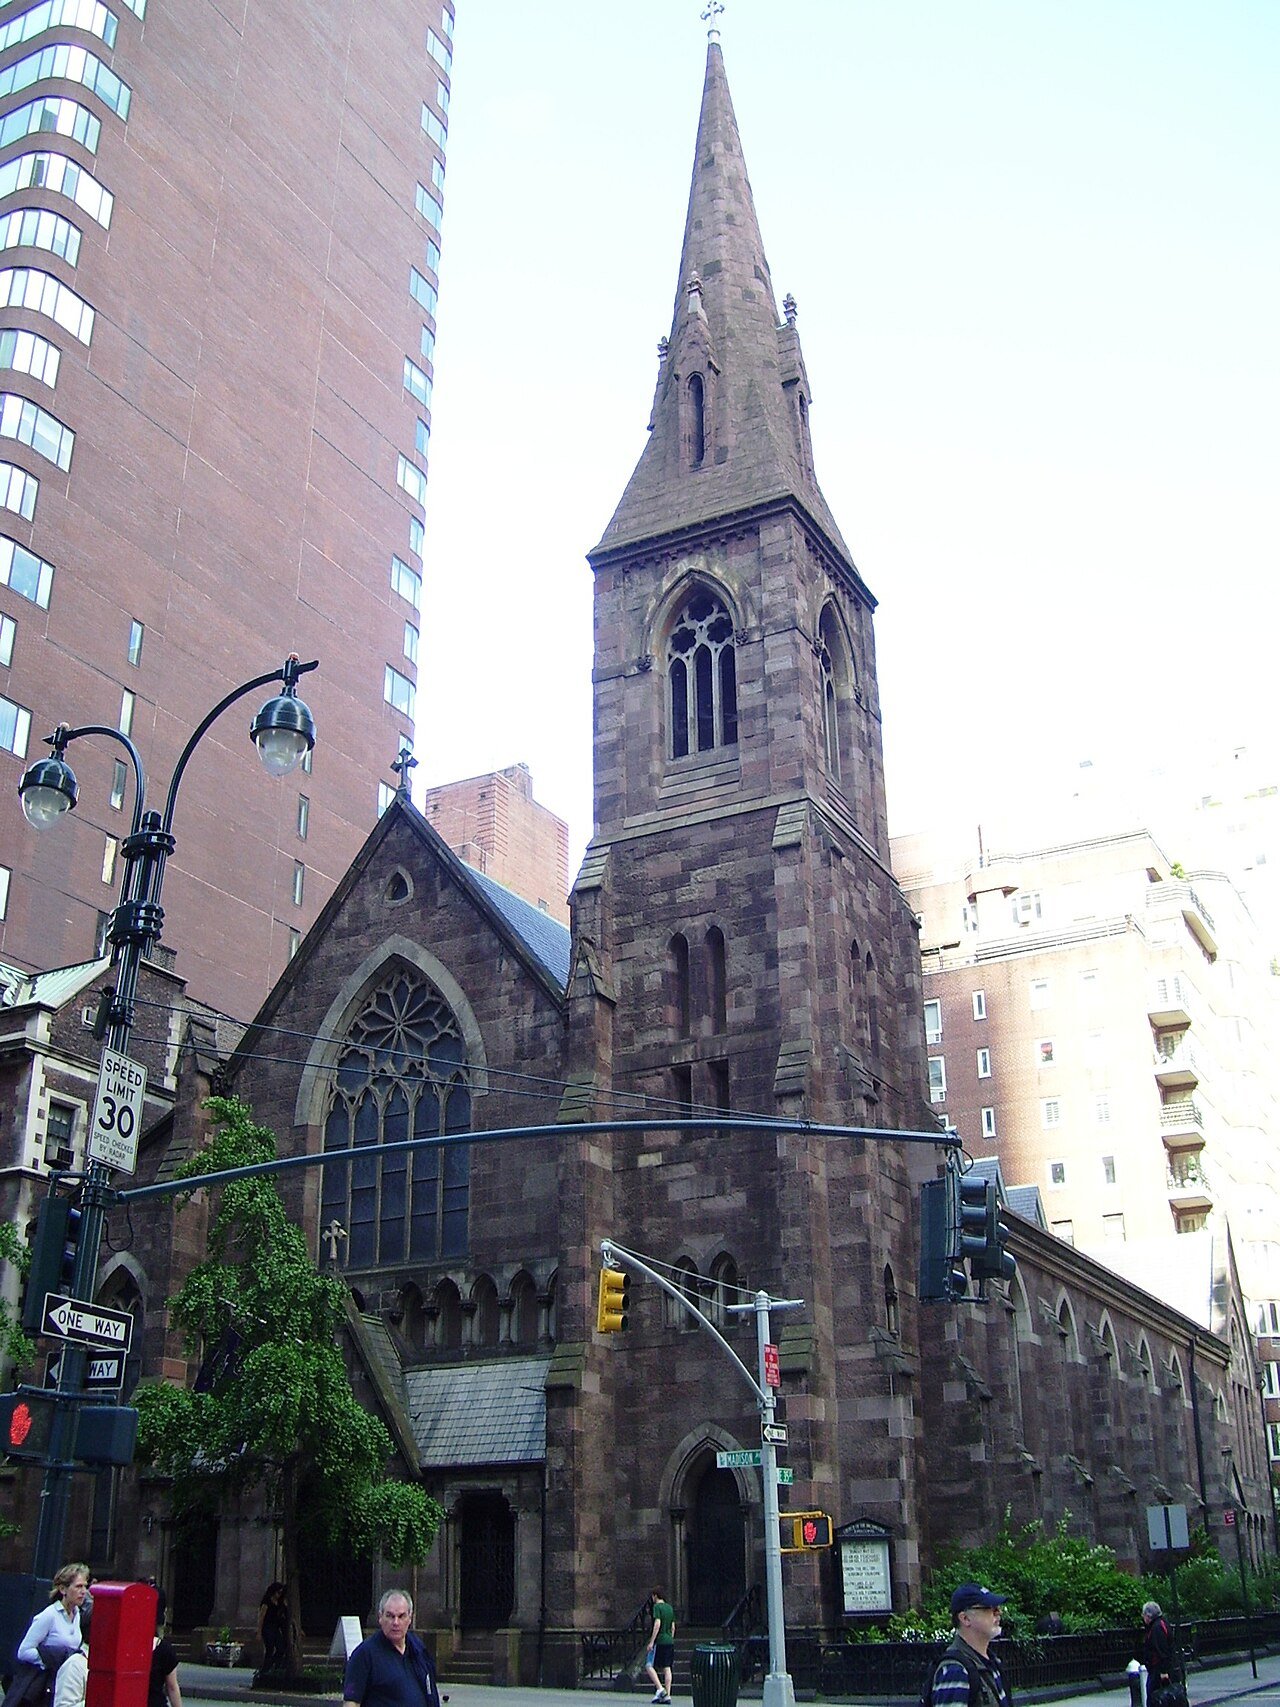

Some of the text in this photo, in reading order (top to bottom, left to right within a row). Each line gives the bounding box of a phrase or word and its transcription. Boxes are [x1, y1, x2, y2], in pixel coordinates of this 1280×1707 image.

[105, 1059, 142, 1086] SPEED
[107, 1078, 136, 1102] LIMIT
[98, 1096, 134, 1138] 30
[94, 1131, 134, 1155] SPEED CHECKED
[99, 1144, 126, 1161] BY RADAR
[58, 1310, 121, 1337] ONE WAY
[89, 1362, 113, 1377] WAY
[727, 1452, 753, 1466] MADISON
